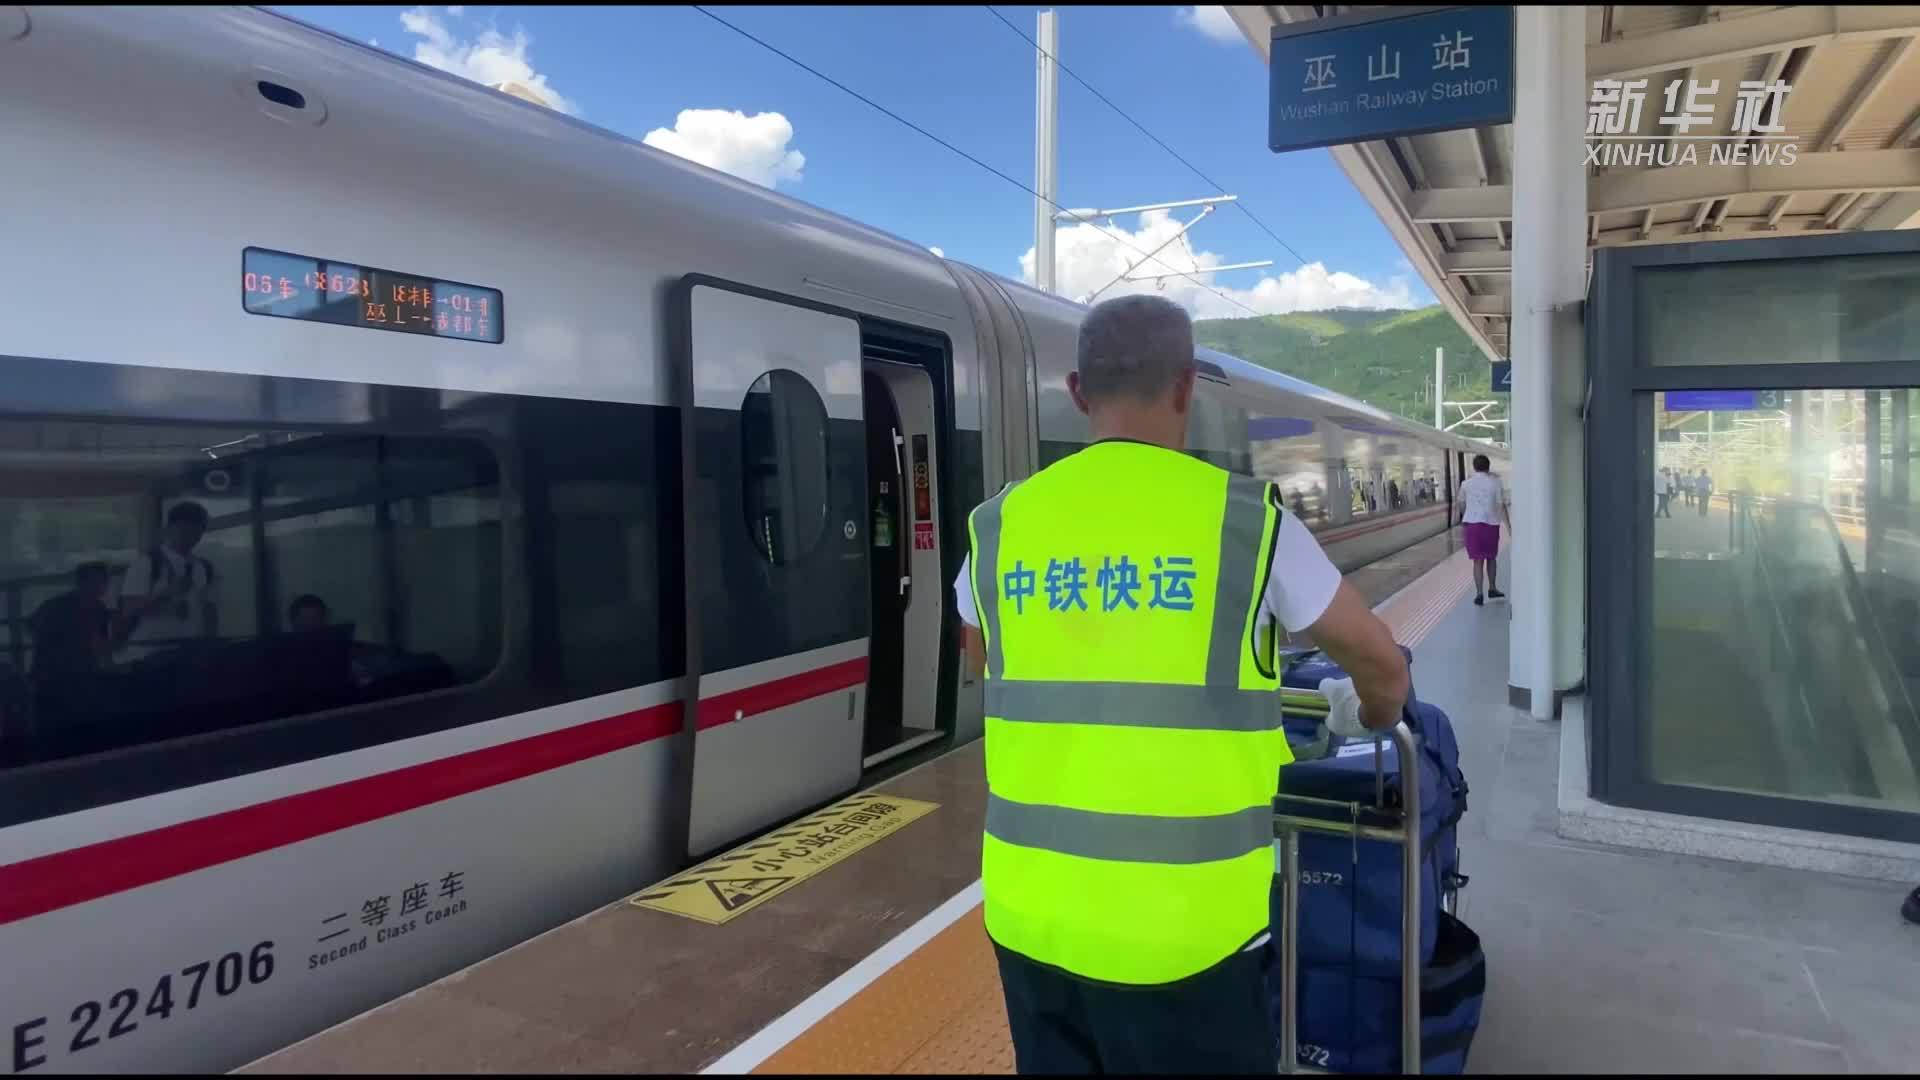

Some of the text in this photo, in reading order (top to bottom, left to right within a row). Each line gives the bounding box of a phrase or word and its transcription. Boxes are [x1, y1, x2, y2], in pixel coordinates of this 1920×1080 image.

[1302, 30, 1474, 93] 巫山站
[1279, 77, 1499, 121] Wushan Railway Station
[1004, 555, 1197, 615] 中铁快运
[317, 871, 465, 943] 二等座车
[1298, 871, 1343, 886] 5572
[308, 900, 468, 970] Second Class Coach
[13, 940, 275, 1074] E 224706
